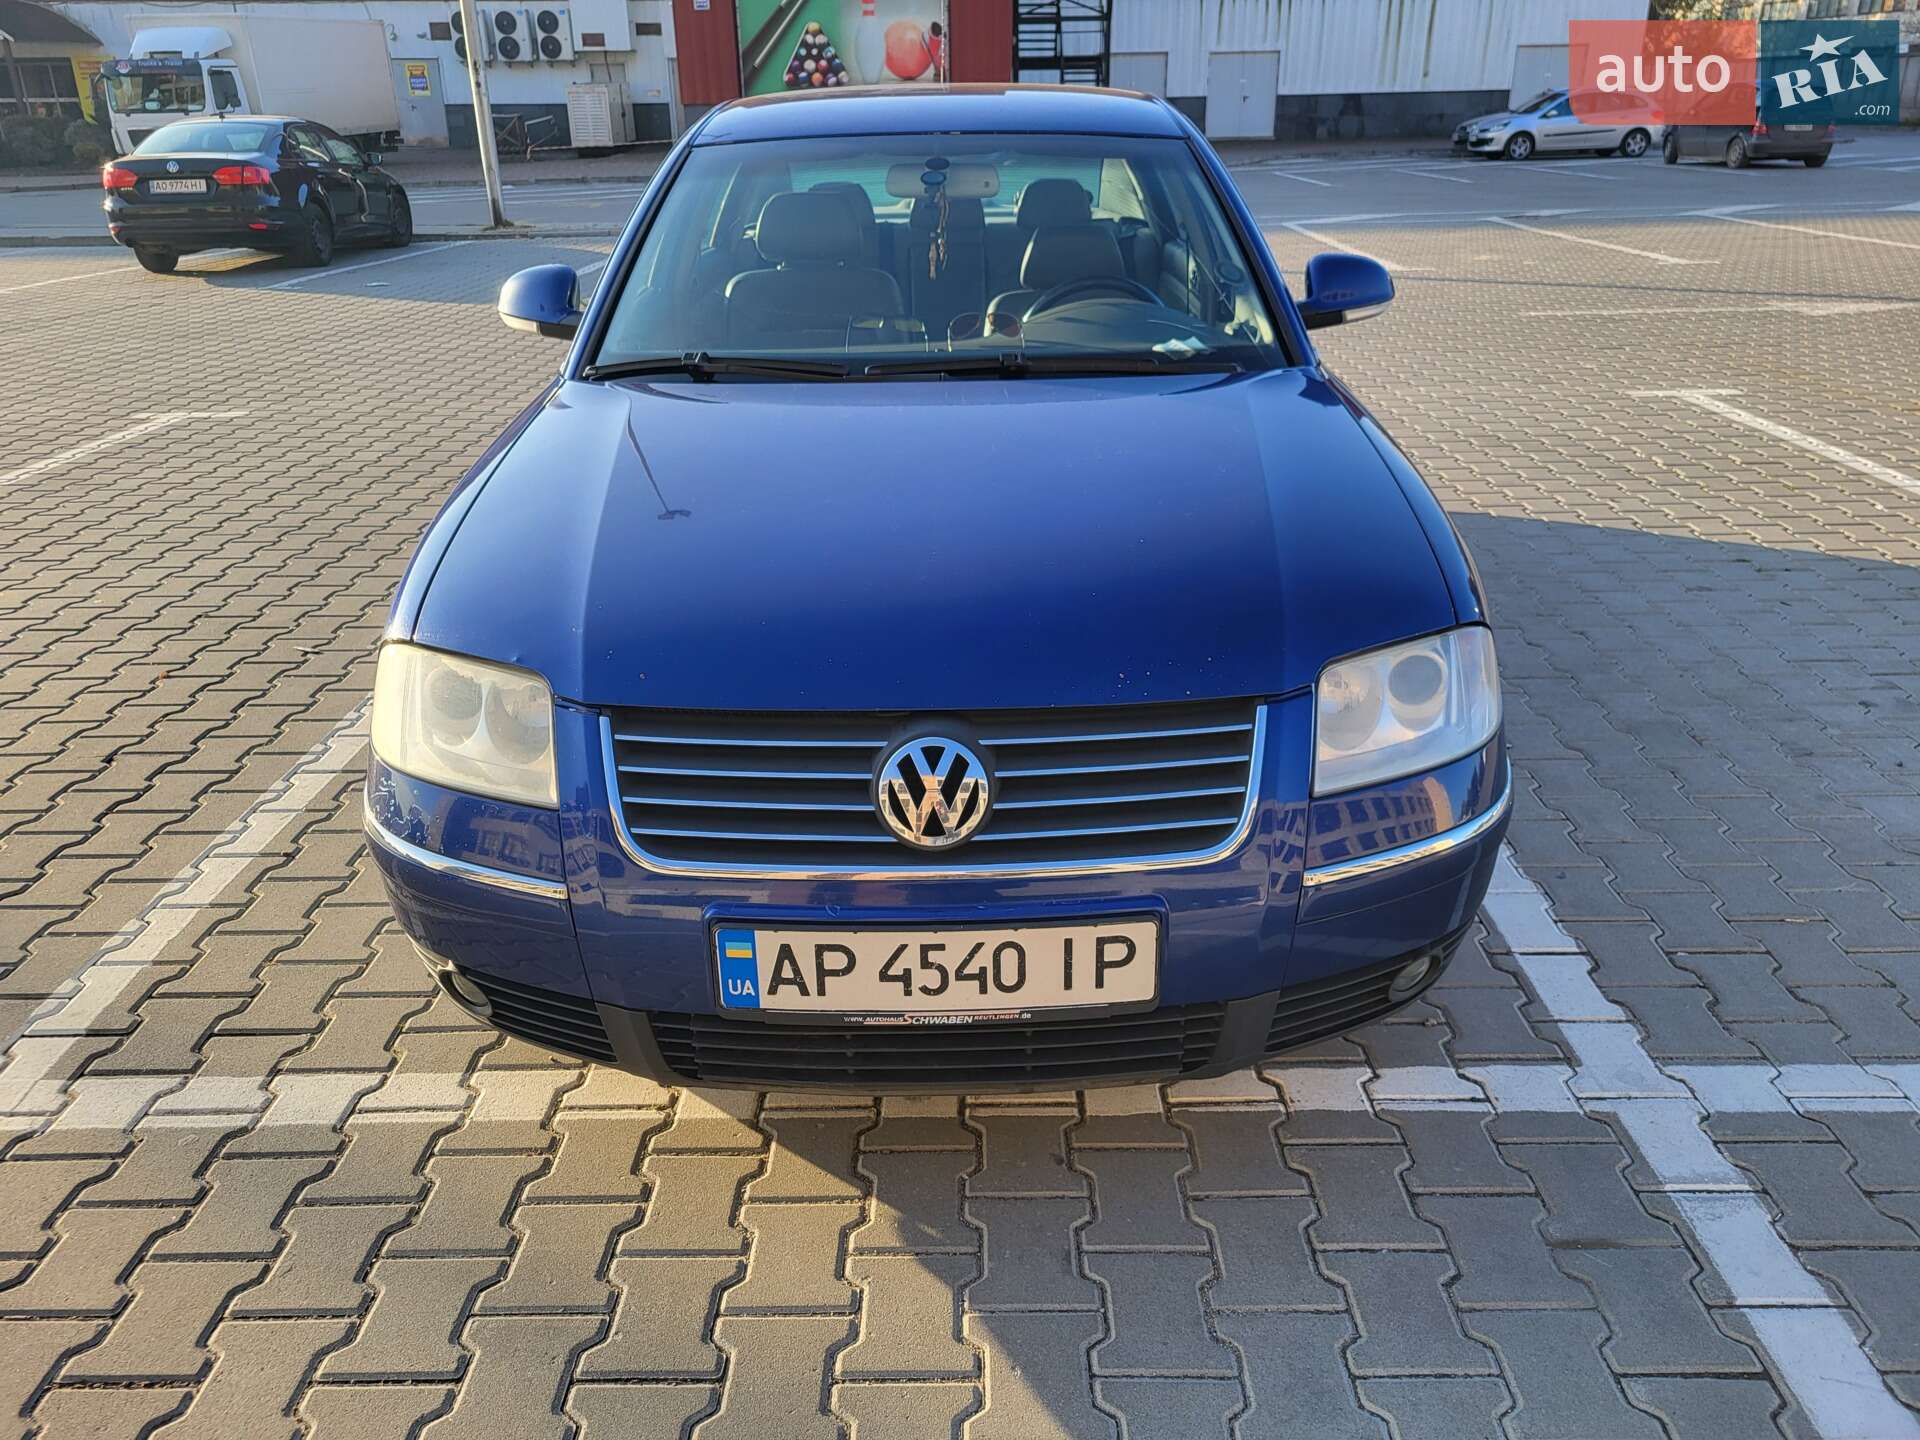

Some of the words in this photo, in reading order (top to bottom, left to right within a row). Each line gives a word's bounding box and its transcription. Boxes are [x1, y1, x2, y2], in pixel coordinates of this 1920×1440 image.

[155, 180, 167, 191] AO
[169, 180, 189, 191] 9774
[767, 943, 857, 997] AP
[878, 940, 1027, 997] 4540
[1063, 935, 1137, 991] IP
[728, 978, 756, 997] UA
